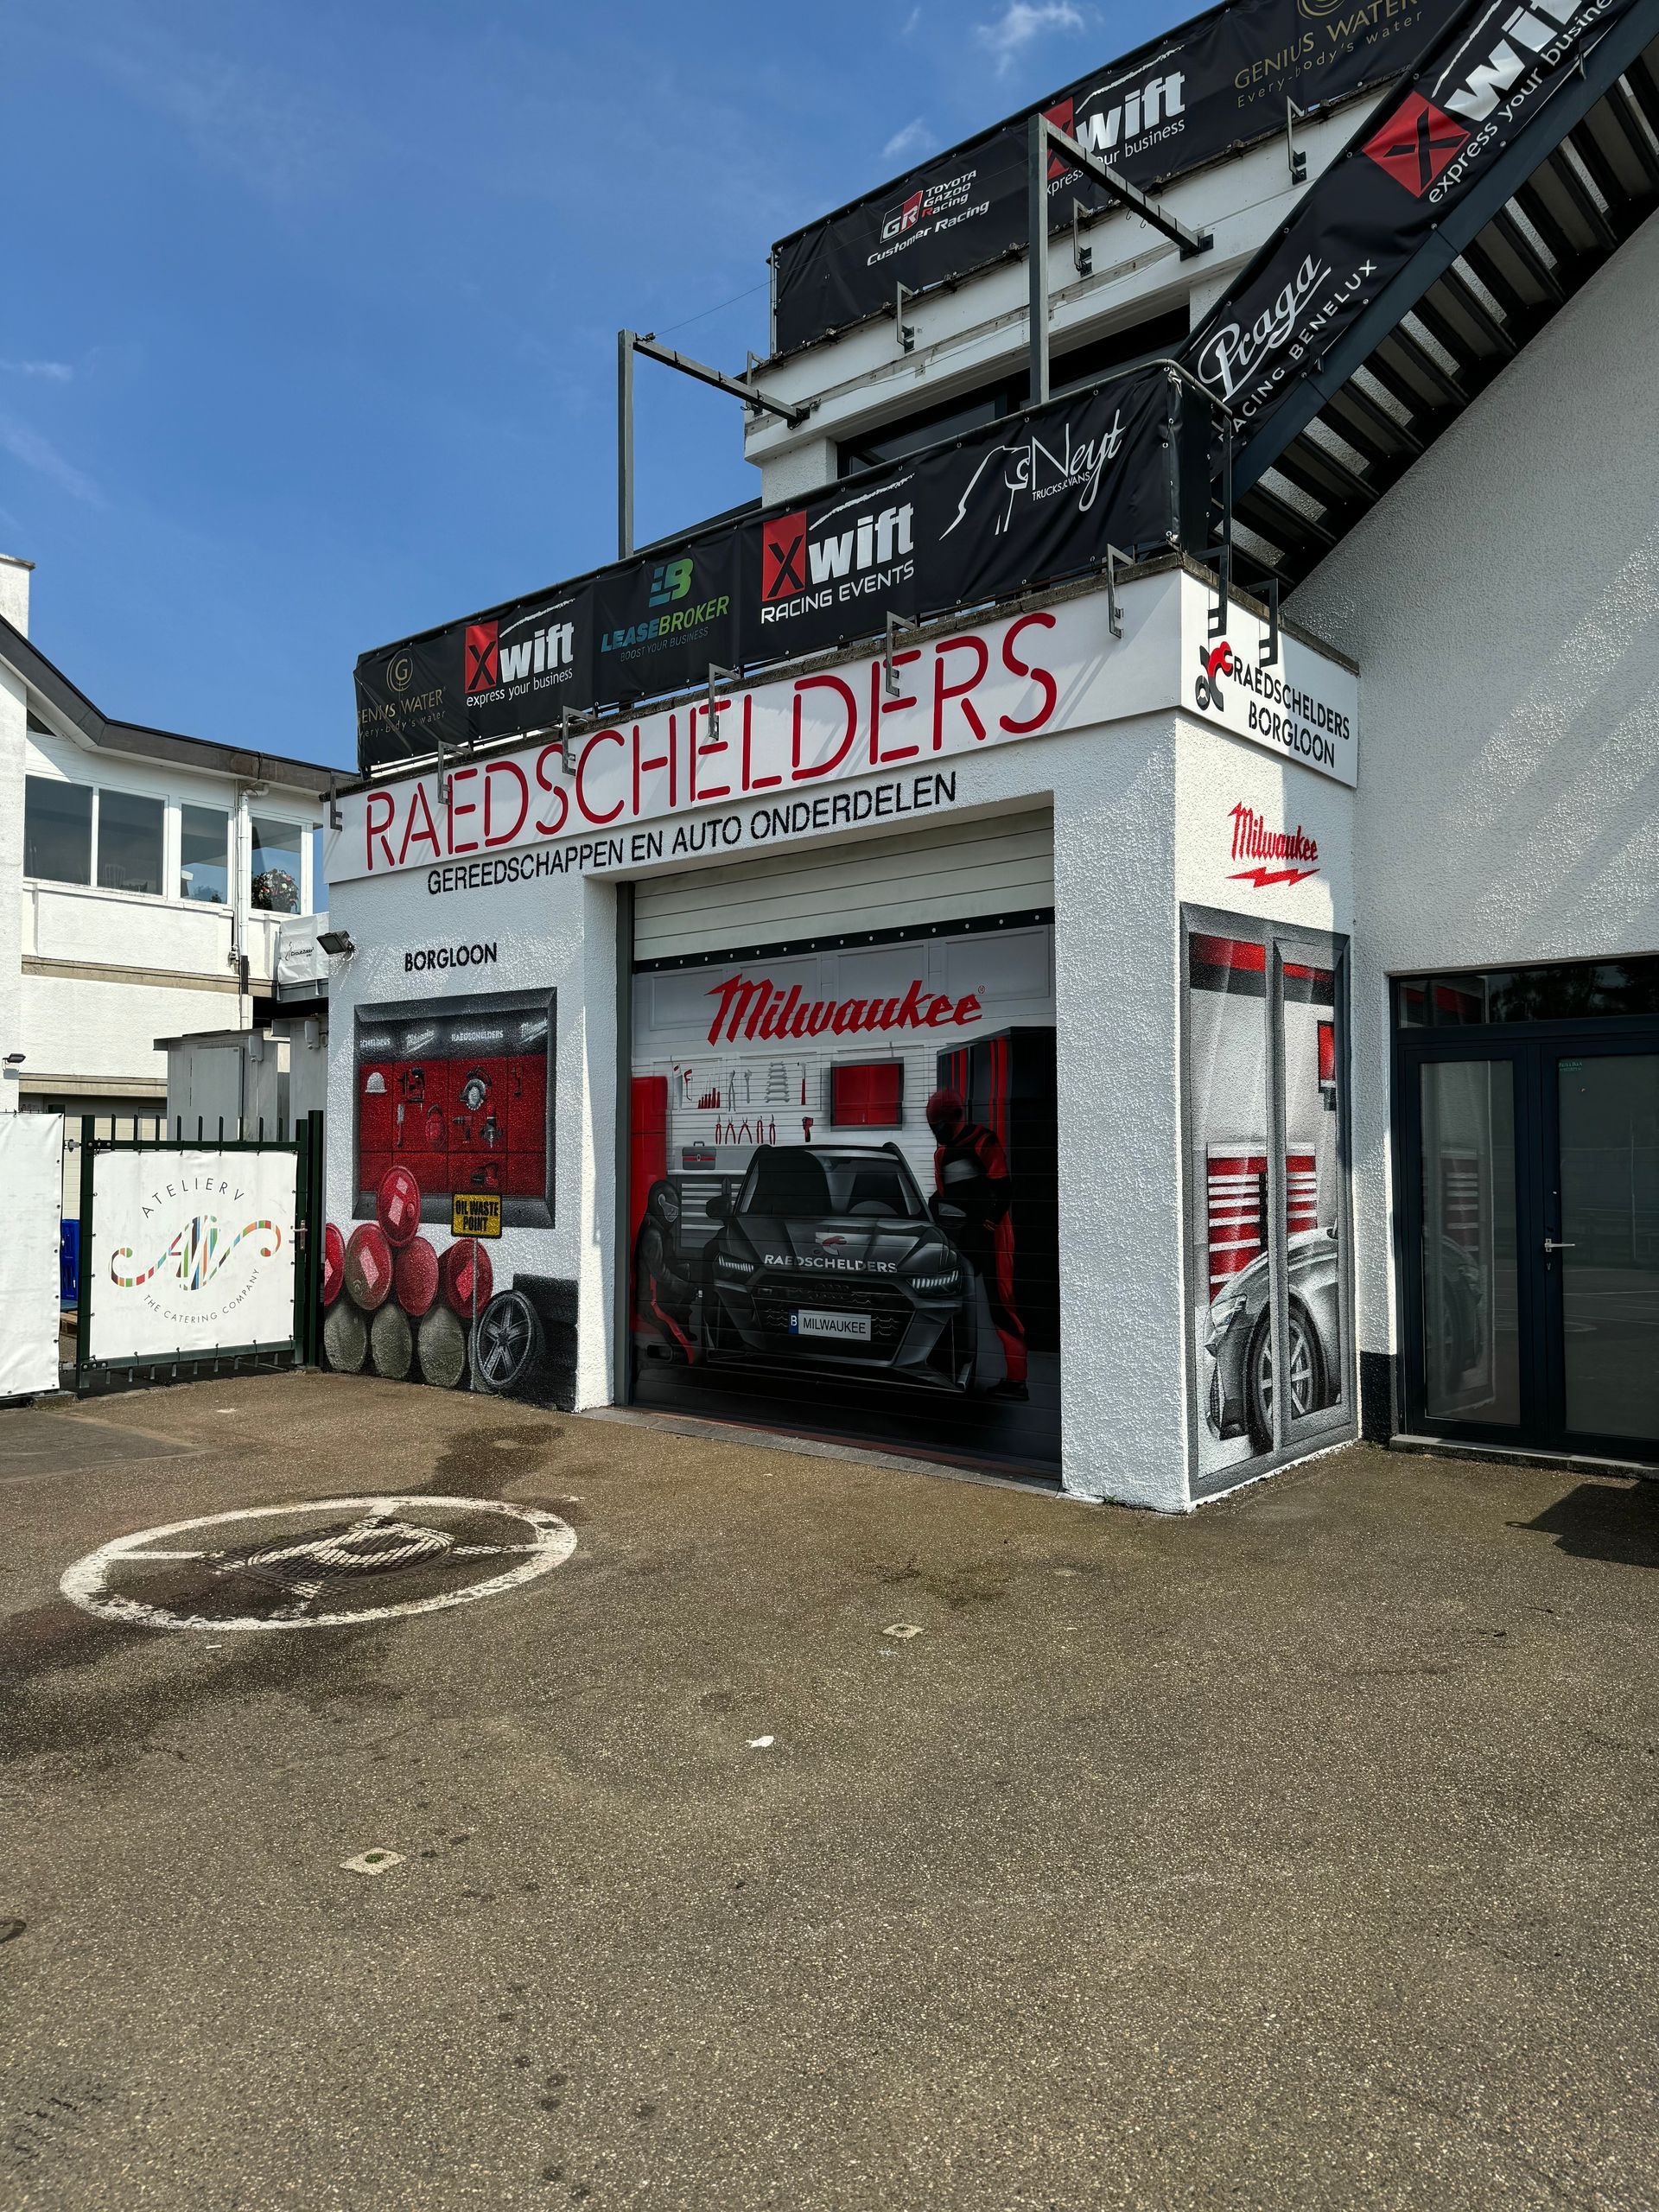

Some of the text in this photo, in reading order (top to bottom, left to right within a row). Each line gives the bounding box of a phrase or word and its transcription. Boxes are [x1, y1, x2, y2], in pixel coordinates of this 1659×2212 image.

[1366, 11, 1422, 44] water
[1234, 32, 1314, 89] GENIUS
[1047, 169, 1084, 196] xpress
[1125, 119, 1185, 158] business
[1428, 123, 1498, 203] express
[1497, 67, 1544, 123] your
[922, 193, 969, 219] Racing
[923, 182, 971, 208] GAZOO
[925, 169, 976, 198] TOYOTA
[867, 200, 990, 266] Customer Racing
[882, 205, 918, 239] GR
[1198, 254, 1332, 403] Praga
[1218, 259, 1377, 442] ACING BENELUX
[1032, 409, 1126, 512] Neyt
[766, 502, 914, 599] Xwift
[760, 559, 914, 624] RACING EVENTS
[601, 595, 730, 652] LEASEBROKER
[620, 626, 709, 662] BOOST YOUR BUSINESS
[467, 621, 575, 691] Xwift
[401, 689, 442, 715] WATER
[467, 668, 573, 708] express your business
[1233, 656, 1350, 741] RAEDSCHELDERS
[366, 613, 1058, 871] RAEDSCHELDERS
[420, 710, 446, 724] water
[1249, 701, 1335, 768] BORGLOON
[428, 771, 957, 894] GEREEDSCHAPPEN EN AUTO ONDERDELEN
[1227, 801, 1319, 861] Milwaukee
[404, 942, 498, 972] BORGLOON
[703, 973, 983, 1046] Milwaukee
[455, 1200, 499, 1217] OIL WASTE
[463, 1216, 488, 1231] POINT
[764, 1254, 897, 1273] RAEDSCHELDERS
[143, 1268, 259, 1324] THE CATERING COMPANY
[791, 1315, 867, 1334] B MILWAUKEE
